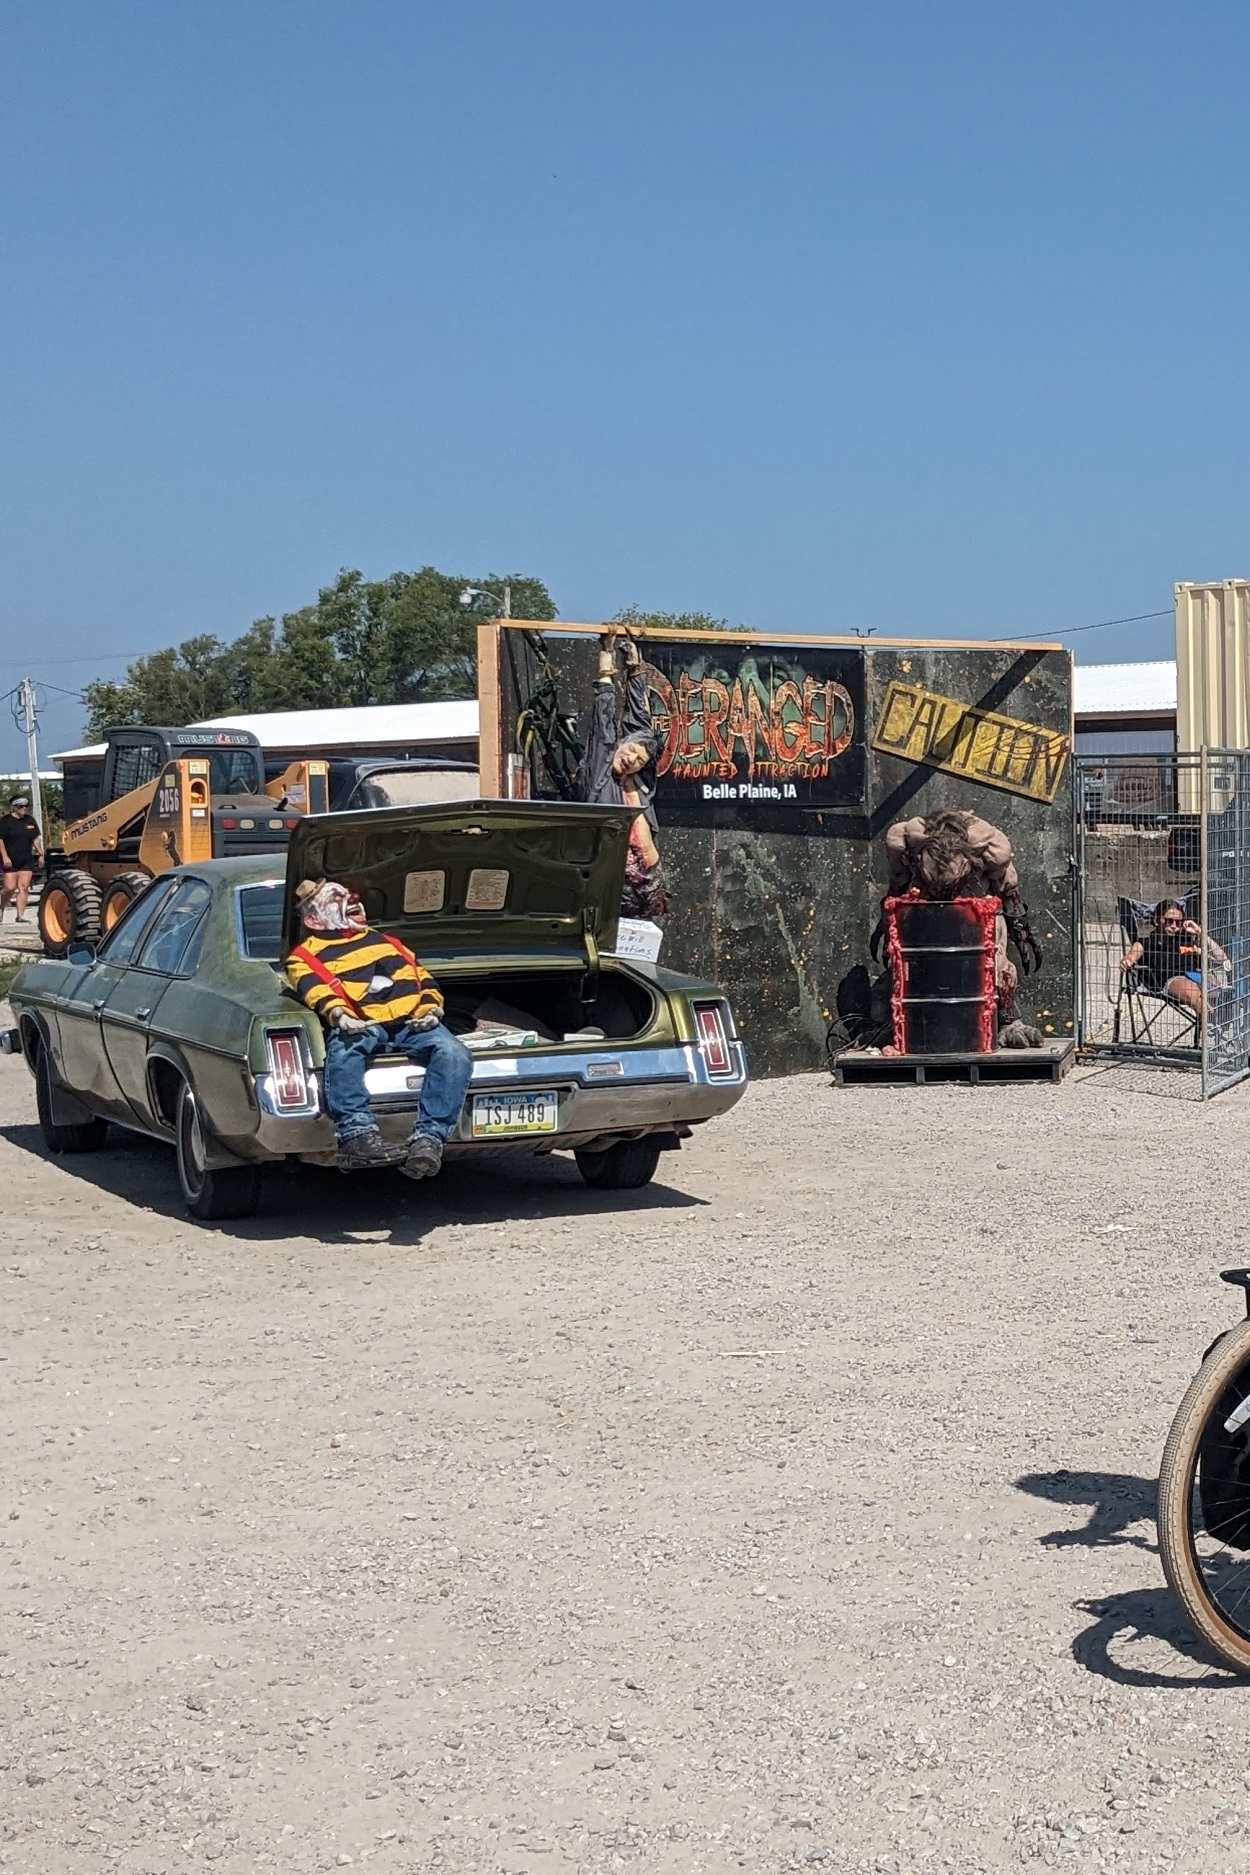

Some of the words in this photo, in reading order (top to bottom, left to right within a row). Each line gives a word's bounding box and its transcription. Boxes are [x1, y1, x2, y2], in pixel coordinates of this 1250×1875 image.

[877, 688, 1067, 796] CAUTION
[672, 761, 738, 779] HAUNTED
[748, 761, 829, 779] ATTRACTION
[160, 788, 180, 813] 2056
[703, 784, 737, 799] Belle
[739, 784, 782, 800] Plaine,
[784, 784, 798, 798] IA
[71, 812, 108, 840] MUSTANG
[503, 1095, 528, 1105] IOWA
[485, 1105, 512, 1126] ISJ
[517, 1103, 545, 1123] 489
